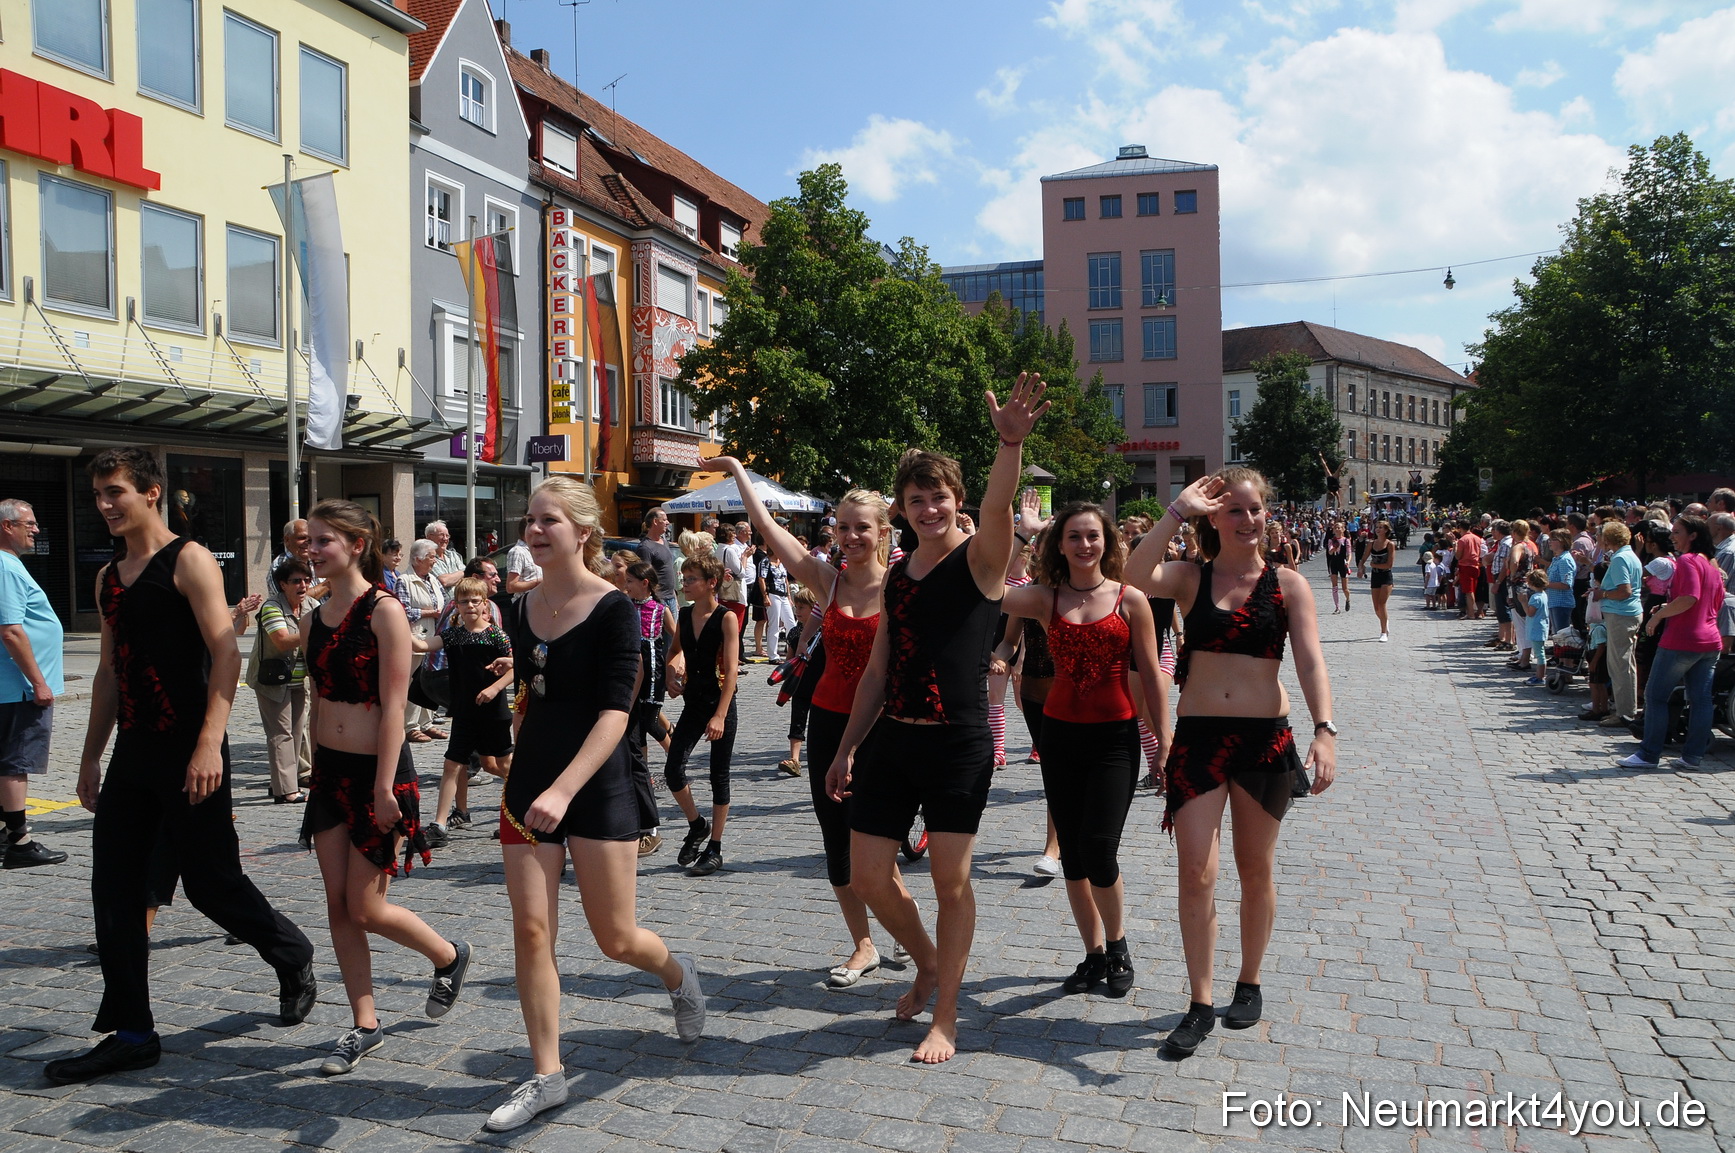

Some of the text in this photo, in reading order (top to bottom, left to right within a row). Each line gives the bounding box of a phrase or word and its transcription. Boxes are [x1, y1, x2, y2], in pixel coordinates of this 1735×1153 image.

[552, 211, 567, 378] BÄCKEREI
[552, 386, 570, 398] café
[461, 434, 485, 453] liert
[532, 441, 563, 456] liberty
[692, 500, 704, 508] Bräu
